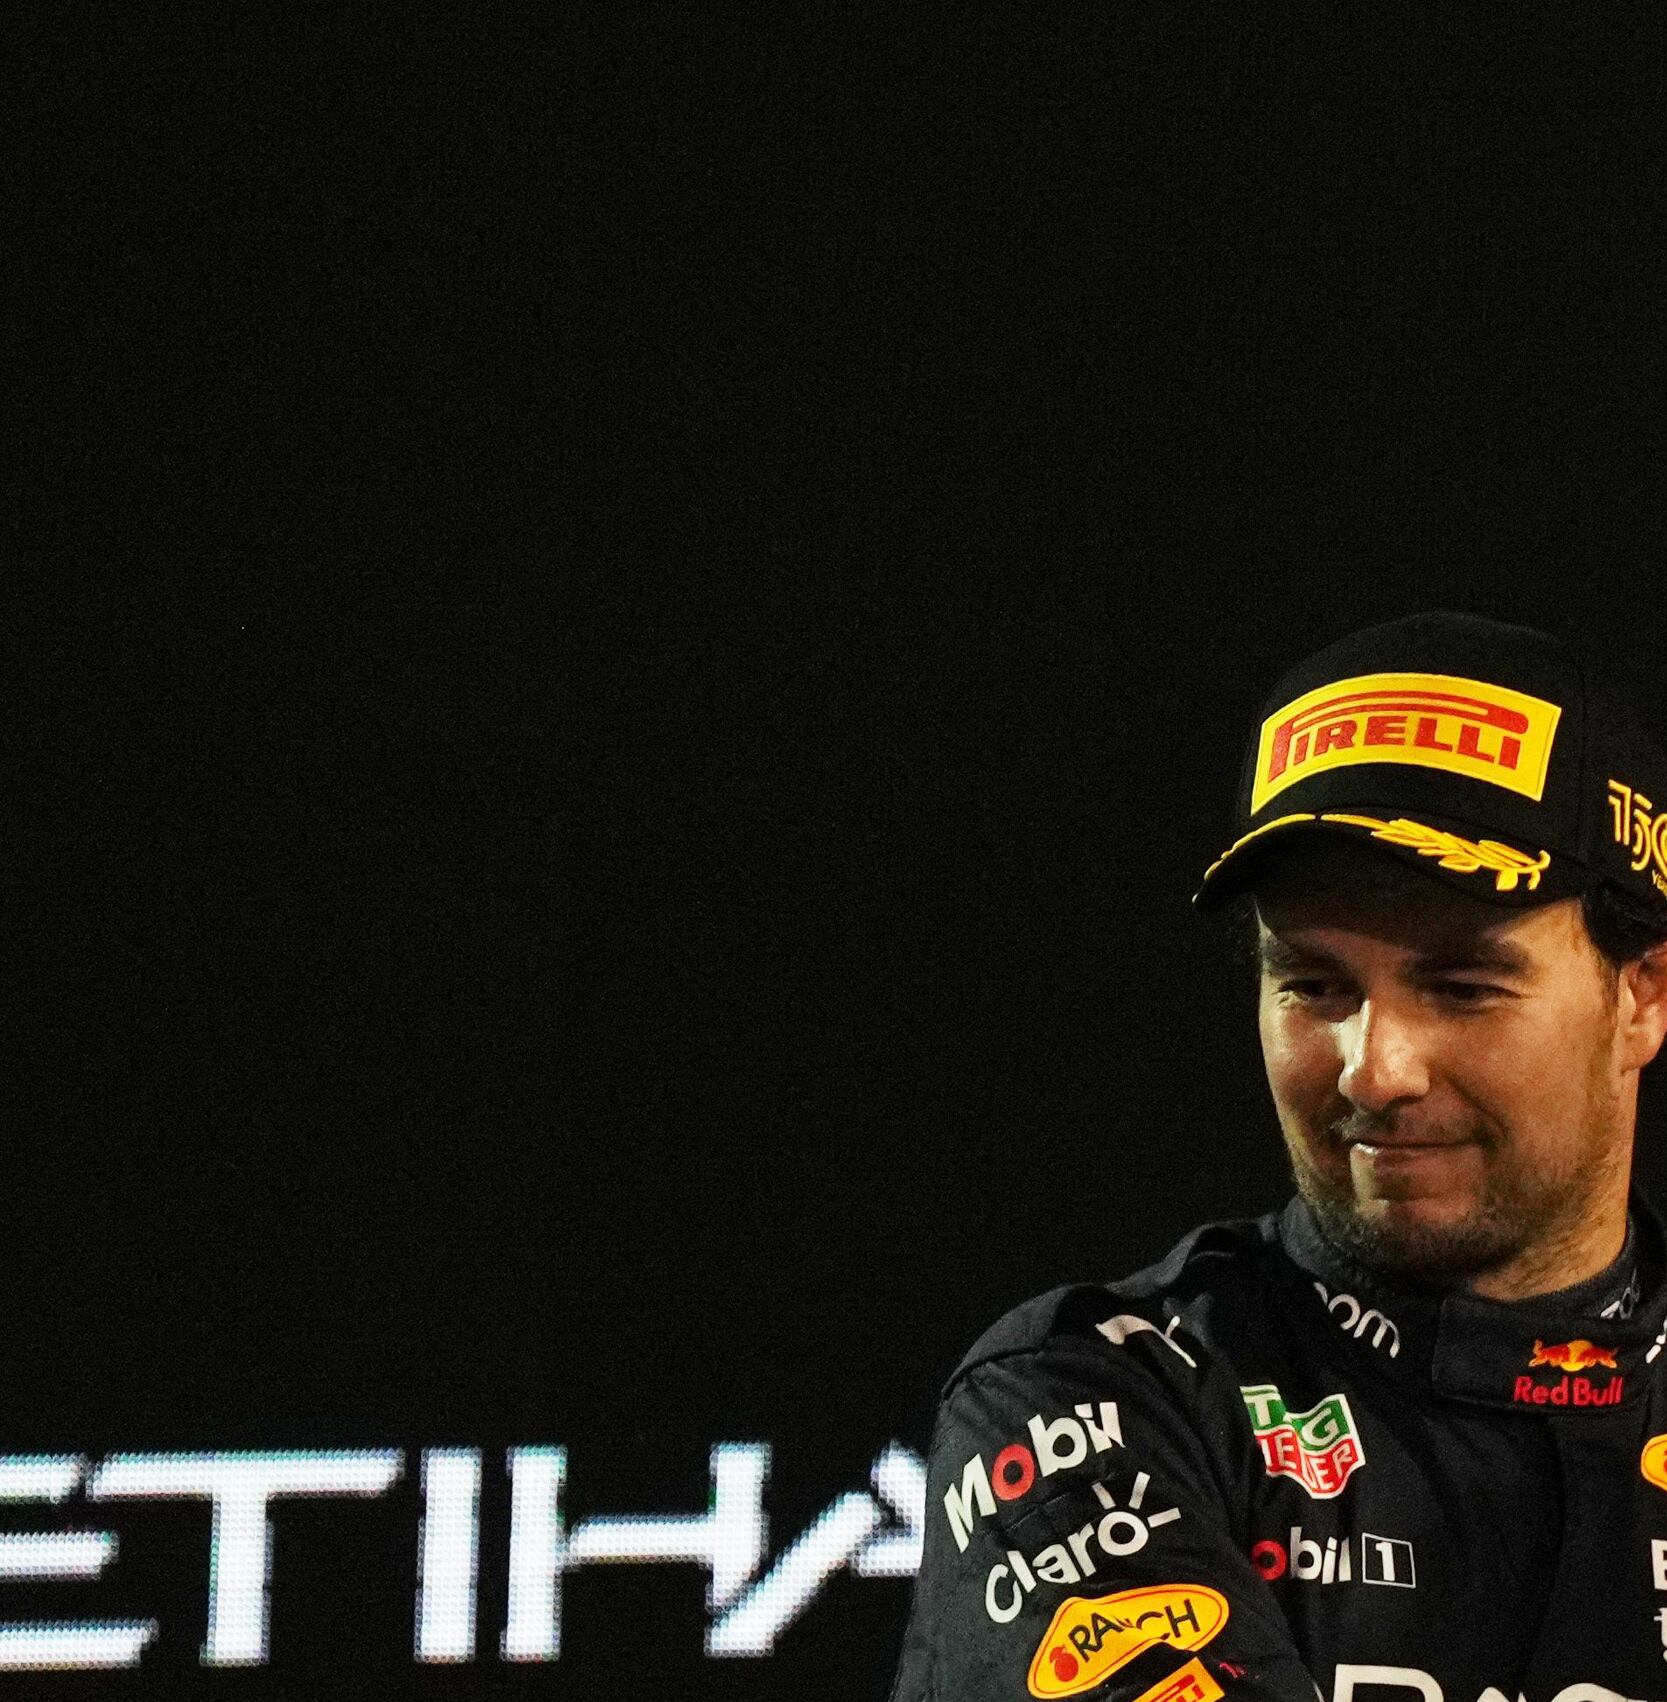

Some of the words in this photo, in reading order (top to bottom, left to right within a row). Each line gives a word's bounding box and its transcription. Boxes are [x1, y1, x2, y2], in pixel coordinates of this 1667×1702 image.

[1267, 689, 1529, 784] PIRELLI
[1313, 1281, 1402, 1359] om
[1243, 1391, 1342, 1447] TG
[1513, 1374, 1568, 1405] Red
[1572, 1376, 1623, 1407] Bull
[943, 1401, 1126, 1554] Mobil
[0, 1440, 925, 1668] ETIHA
[985, 1510, 1150, 1624] Claro
[1250, 1526, 1352, 1585] obil
